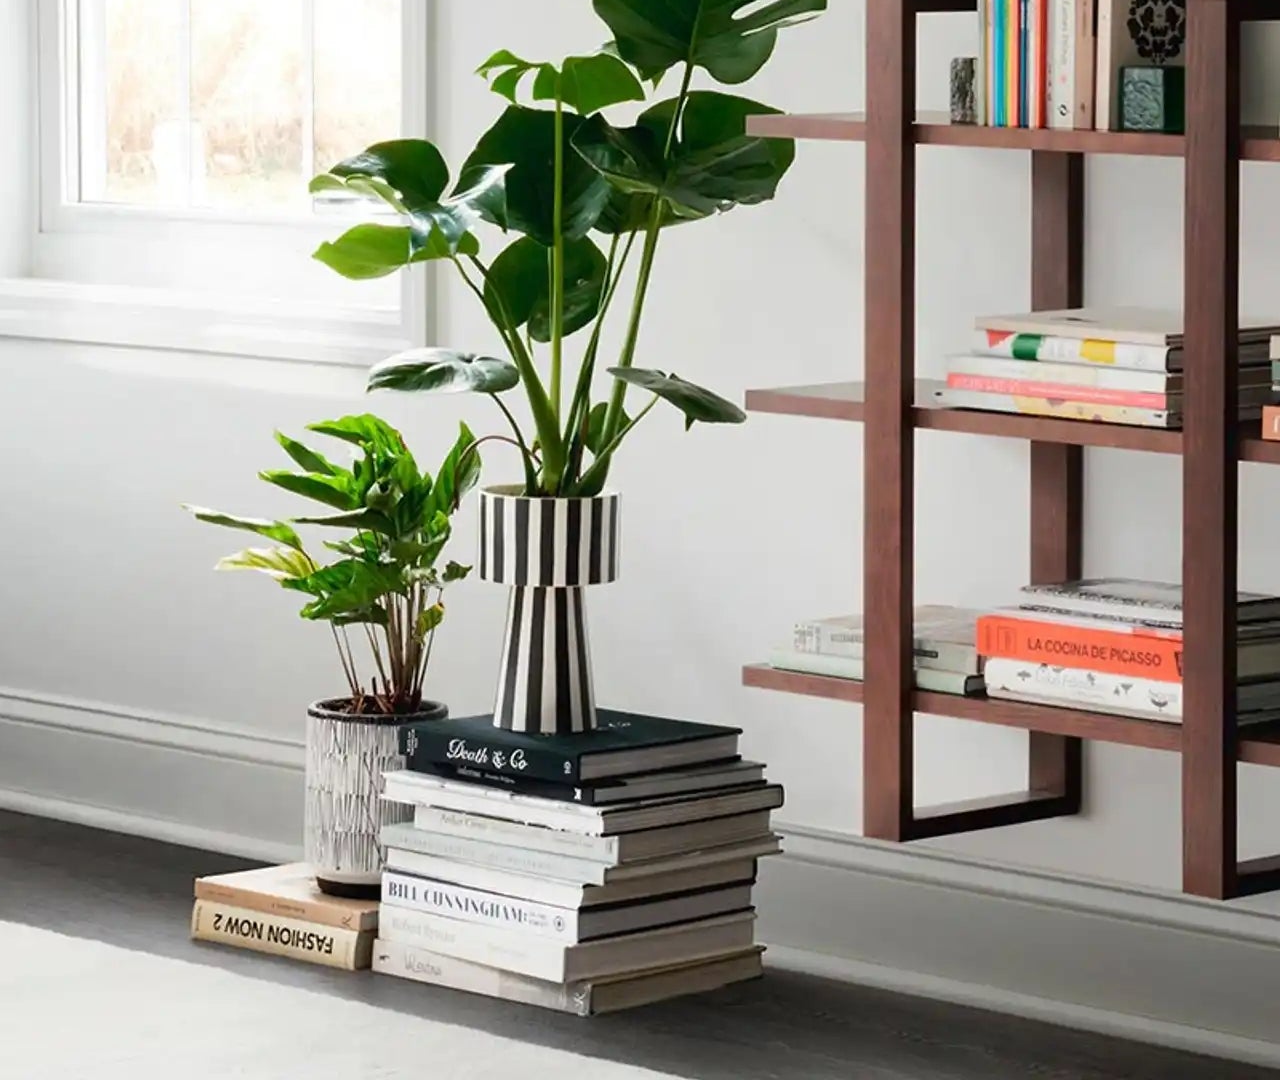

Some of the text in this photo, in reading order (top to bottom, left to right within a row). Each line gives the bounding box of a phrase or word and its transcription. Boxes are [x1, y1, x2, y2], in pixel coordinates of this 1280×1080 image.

[1027, 637, 1161, 667] LA COCINA DE PICASSO
[446, 738, 488, 765] Death
[510, 749, 528, 770] Co
[388, 881, 417, 905] BILL
[213, 913, 334, 955] FASHION NOW 2
